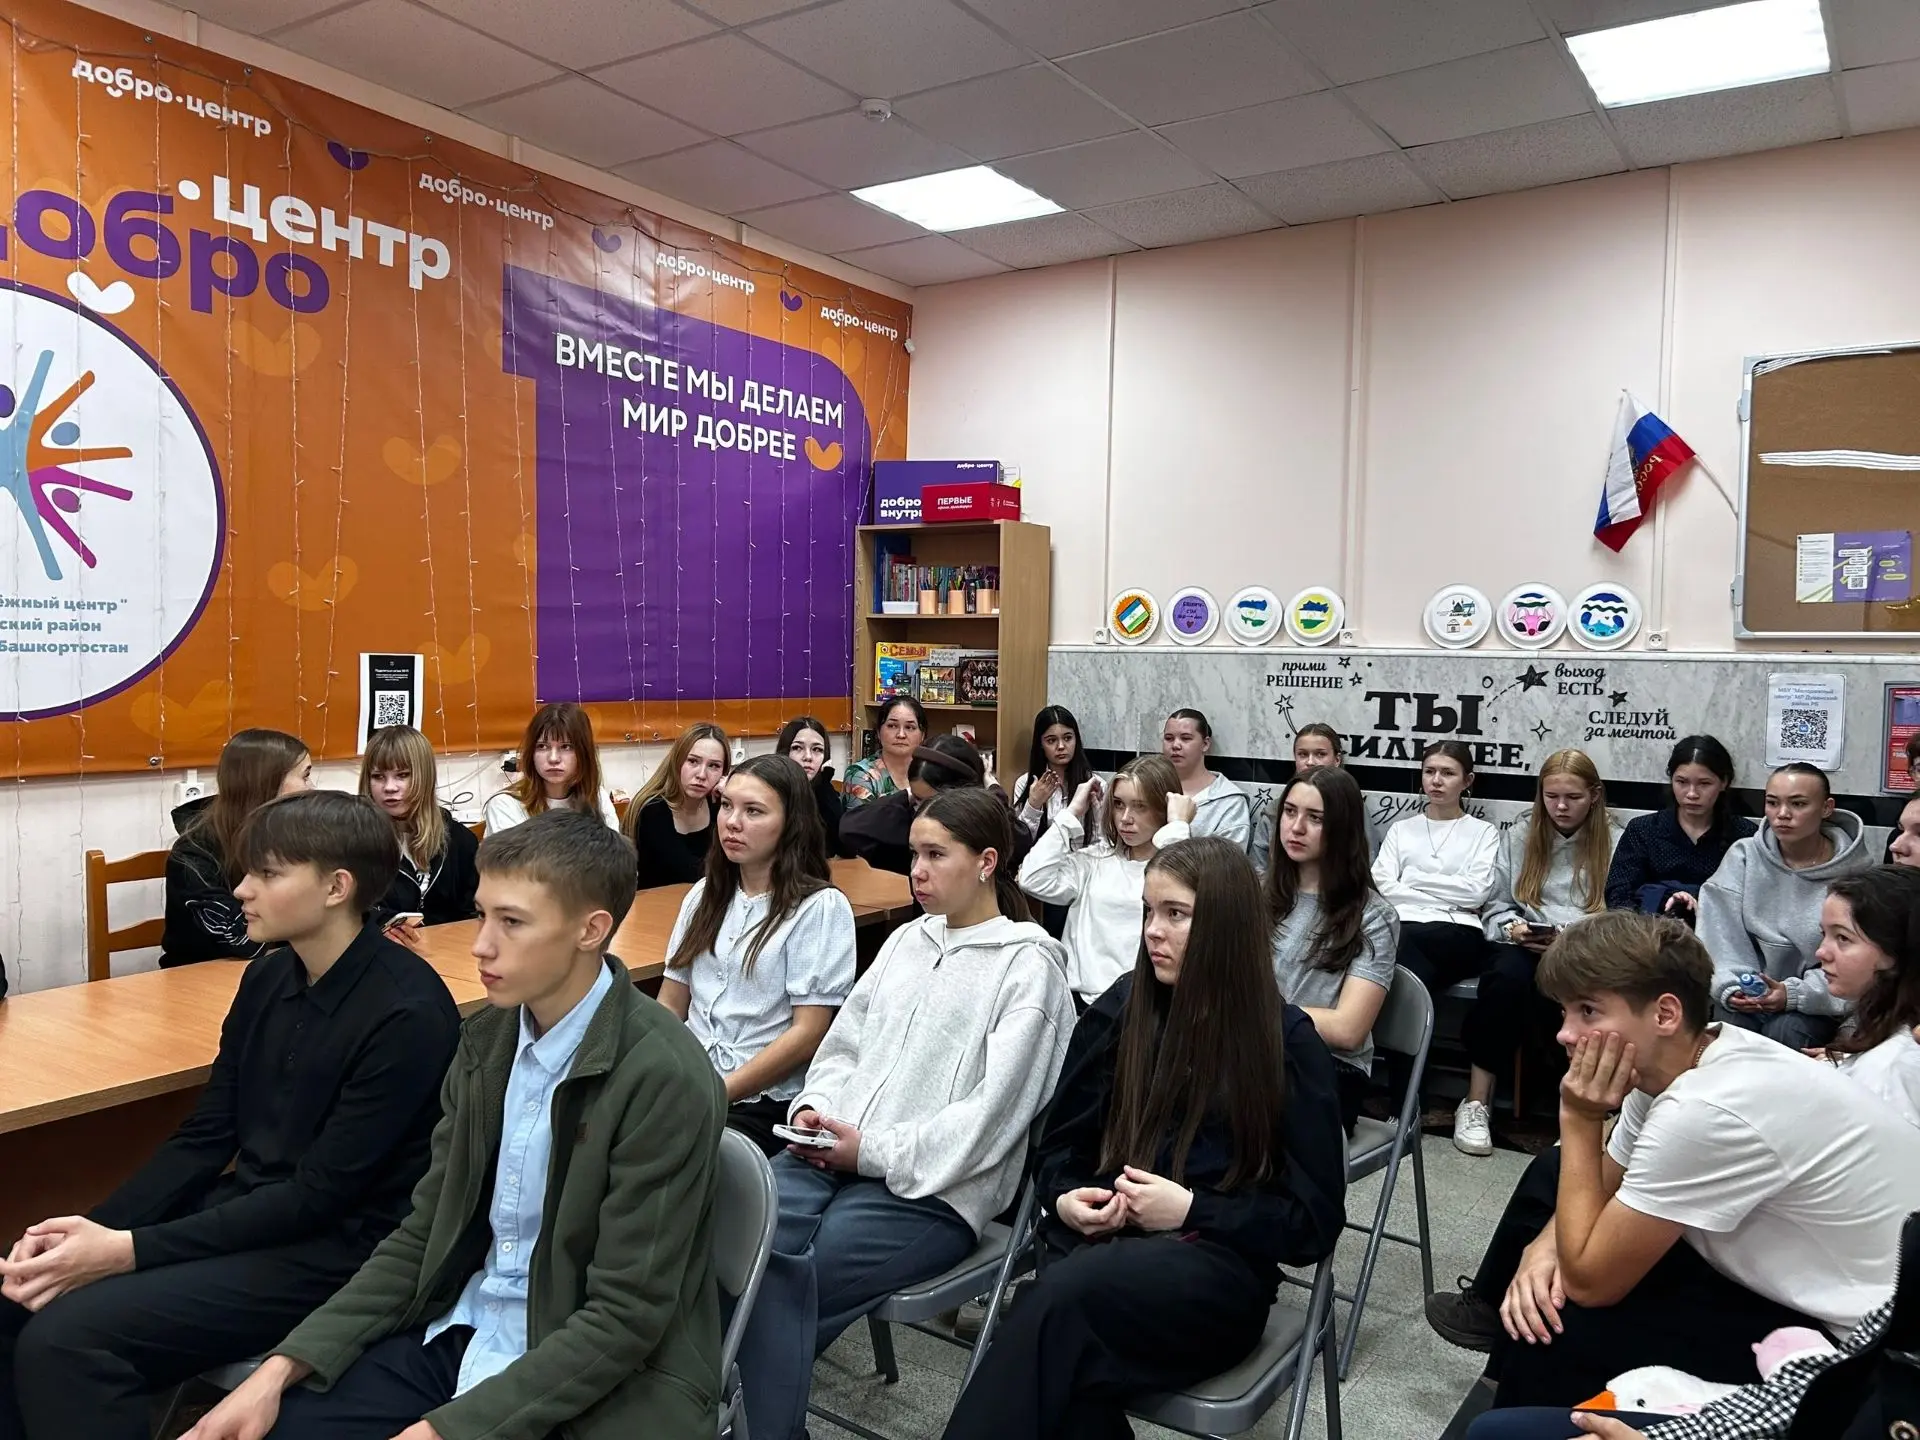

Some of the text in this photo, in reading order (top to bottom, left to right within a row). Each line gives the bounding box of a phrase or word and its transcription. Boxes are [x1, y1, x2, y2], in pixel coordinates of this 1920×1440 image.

[0, 189, 330, 314] обро
[556, 333, 843, 429] ВМЕСТЕ МЫ ДЕЛАЕМ
[623, 397, 796, 461] МИР ДОБРЕЕ
[880, 496, 922, 509] добро
[937, 496, 973, 506] ПЕРВЫЕ
[47, 619, 102, 635] район
[1281, 660, 1327, 674] прими
[1554, 662, 1606, 685] выход
[1266, 674, 1344, 690] РЕШЕНИЕ
[1557, 681, 1605, 697] ЕСТЬ
[1364, 690, 1485, 736] ТЫ
[1589, 708, 1669, 727] СЛЕДУЙ
[1584, 725, 1678, 741] за мечтой
